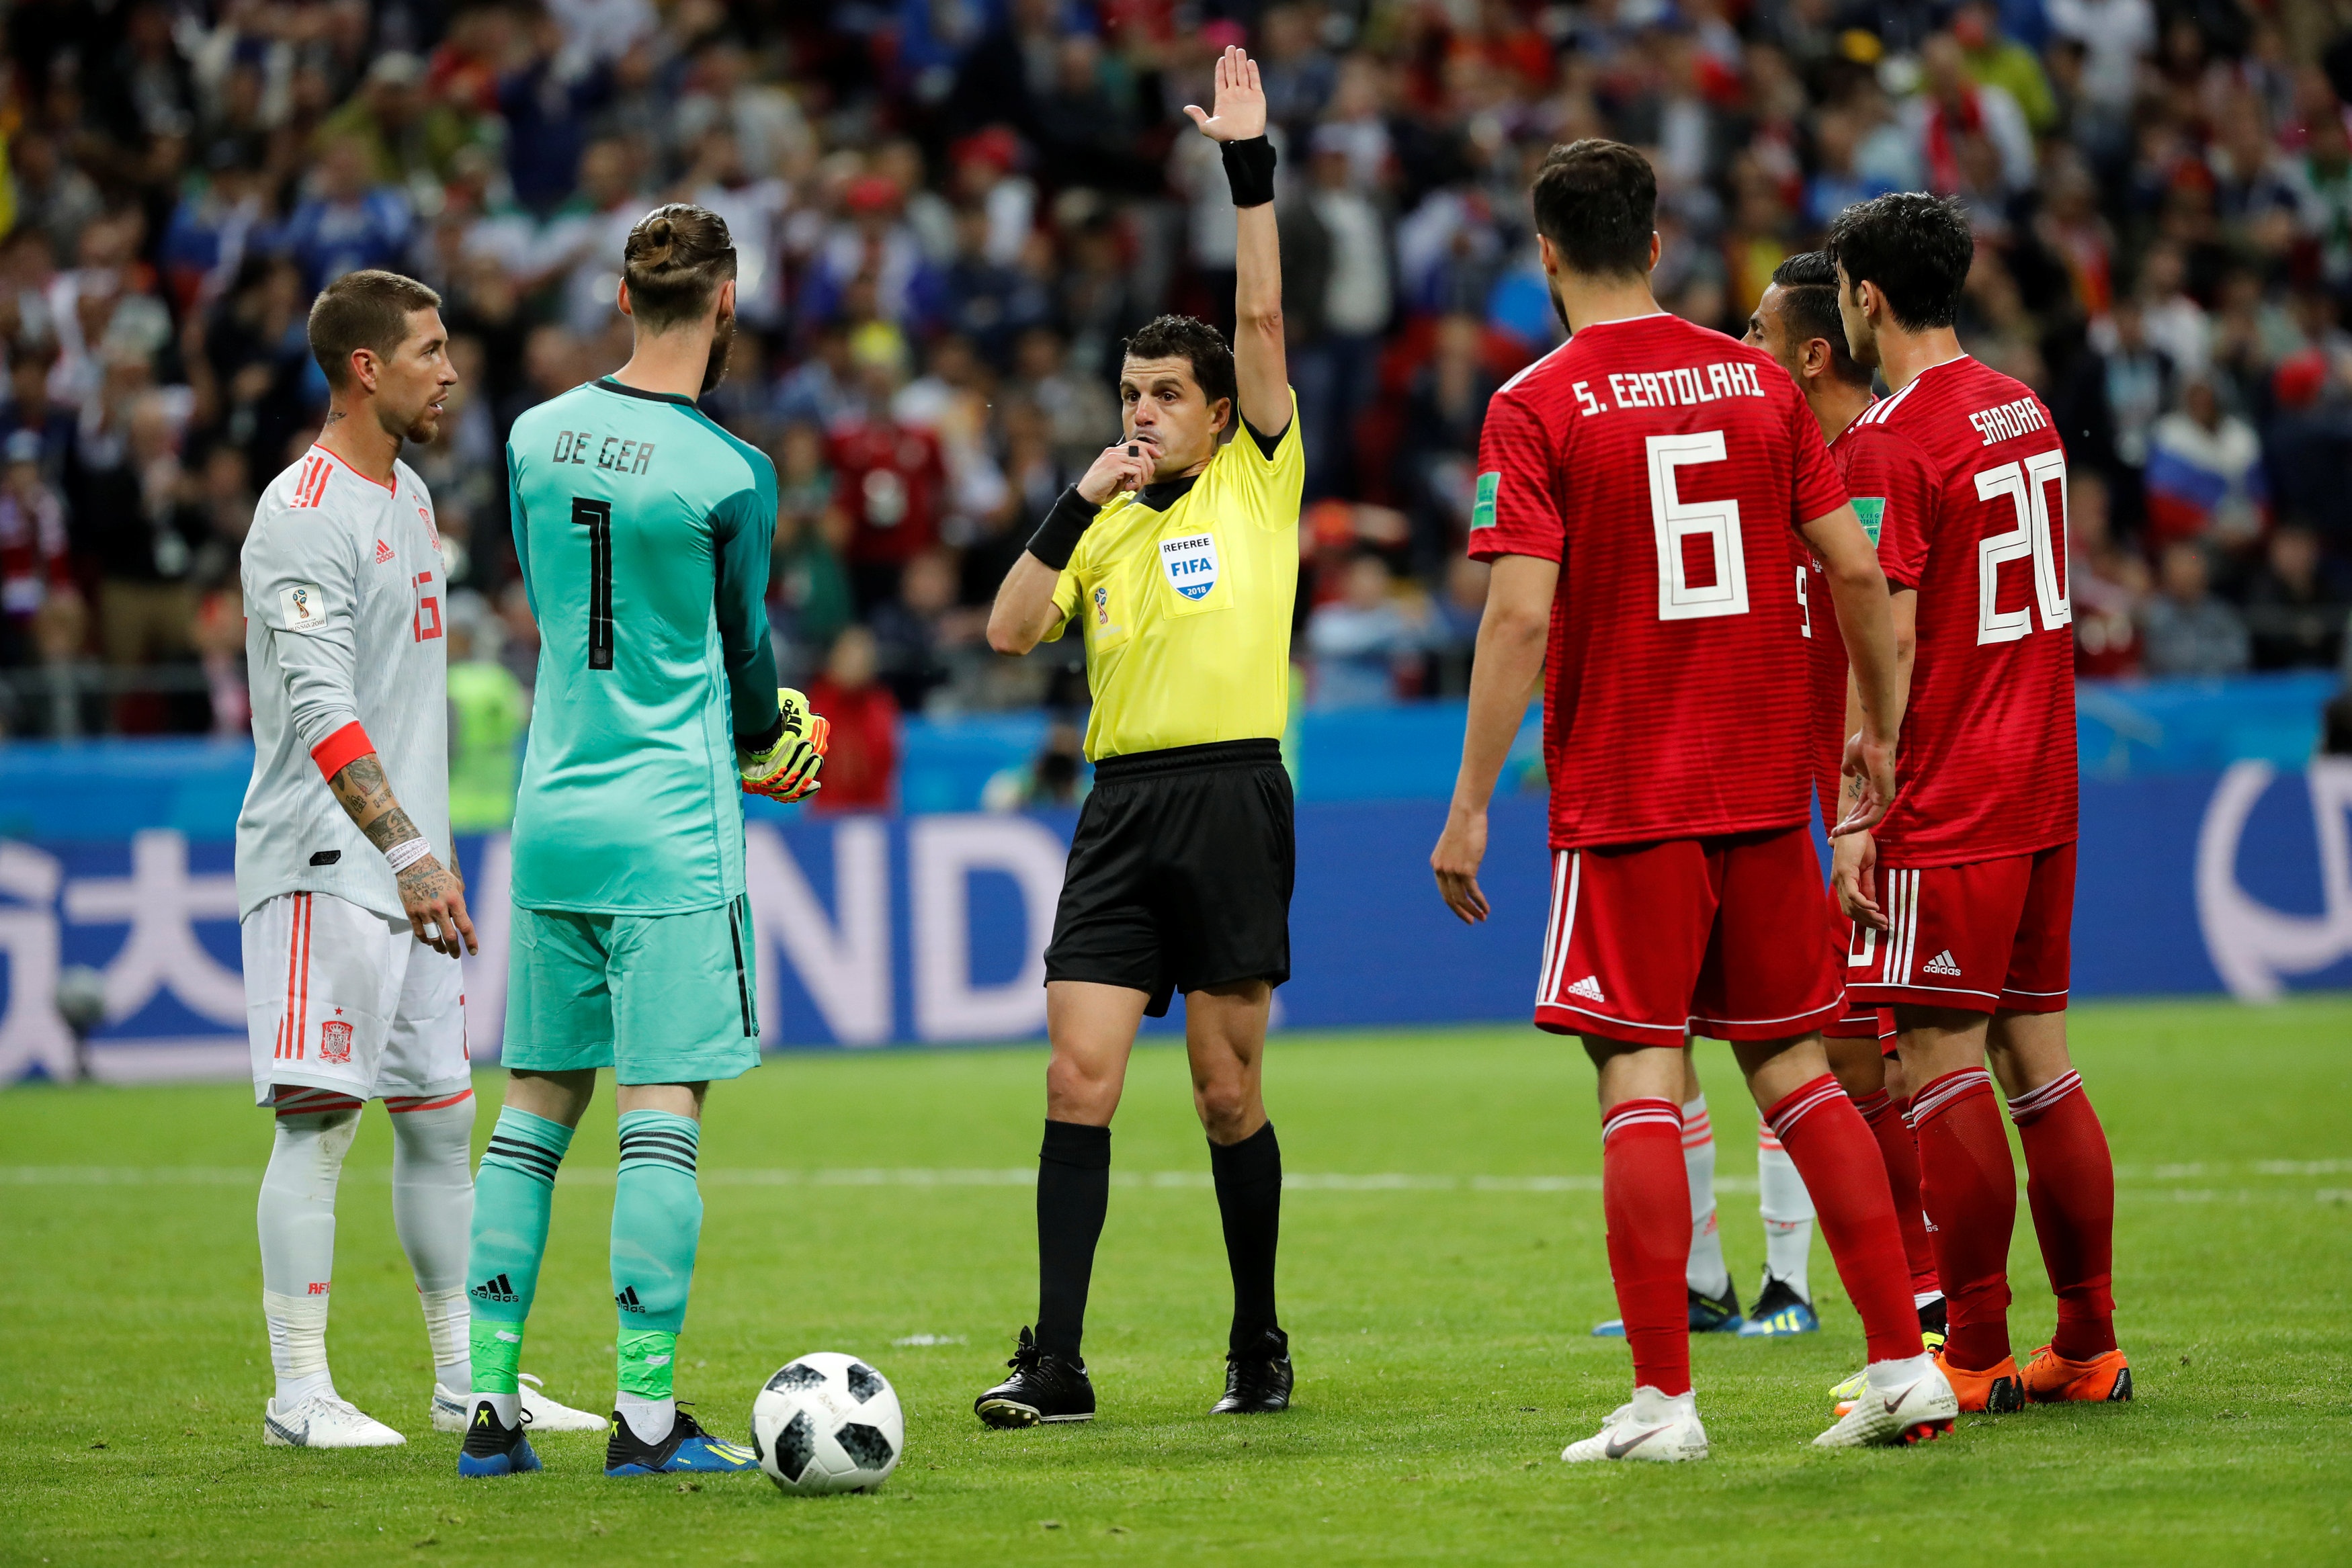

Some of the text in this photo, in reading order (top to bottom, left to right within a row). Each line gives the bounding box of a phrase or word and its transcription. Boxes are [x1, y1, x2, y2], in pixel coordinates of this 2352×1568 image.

[1572, 362, 1765, 417] S. EZATOLAHI
[552, 431, 655, 475] DE GEA
[1645, 430, 1750, 621] 6
[1163, 537, 1210, 552] REFEREE
[1973, 448, 2072, 646] 20
[376, 550, 396, 564] adidas
[1171, 558, 1212, 576] FIFA
[571, 496, 614, 670] 1
[1187, 586, 1207, 596] 2018
[412, 571, 443, 643] 15
[311, 619, 325, 627] 2018
[1923, 964, 1962, 977] adidas
[1567, 985, 1605, 1003] adidas
[470, 1288, 519, 1303] adidas
